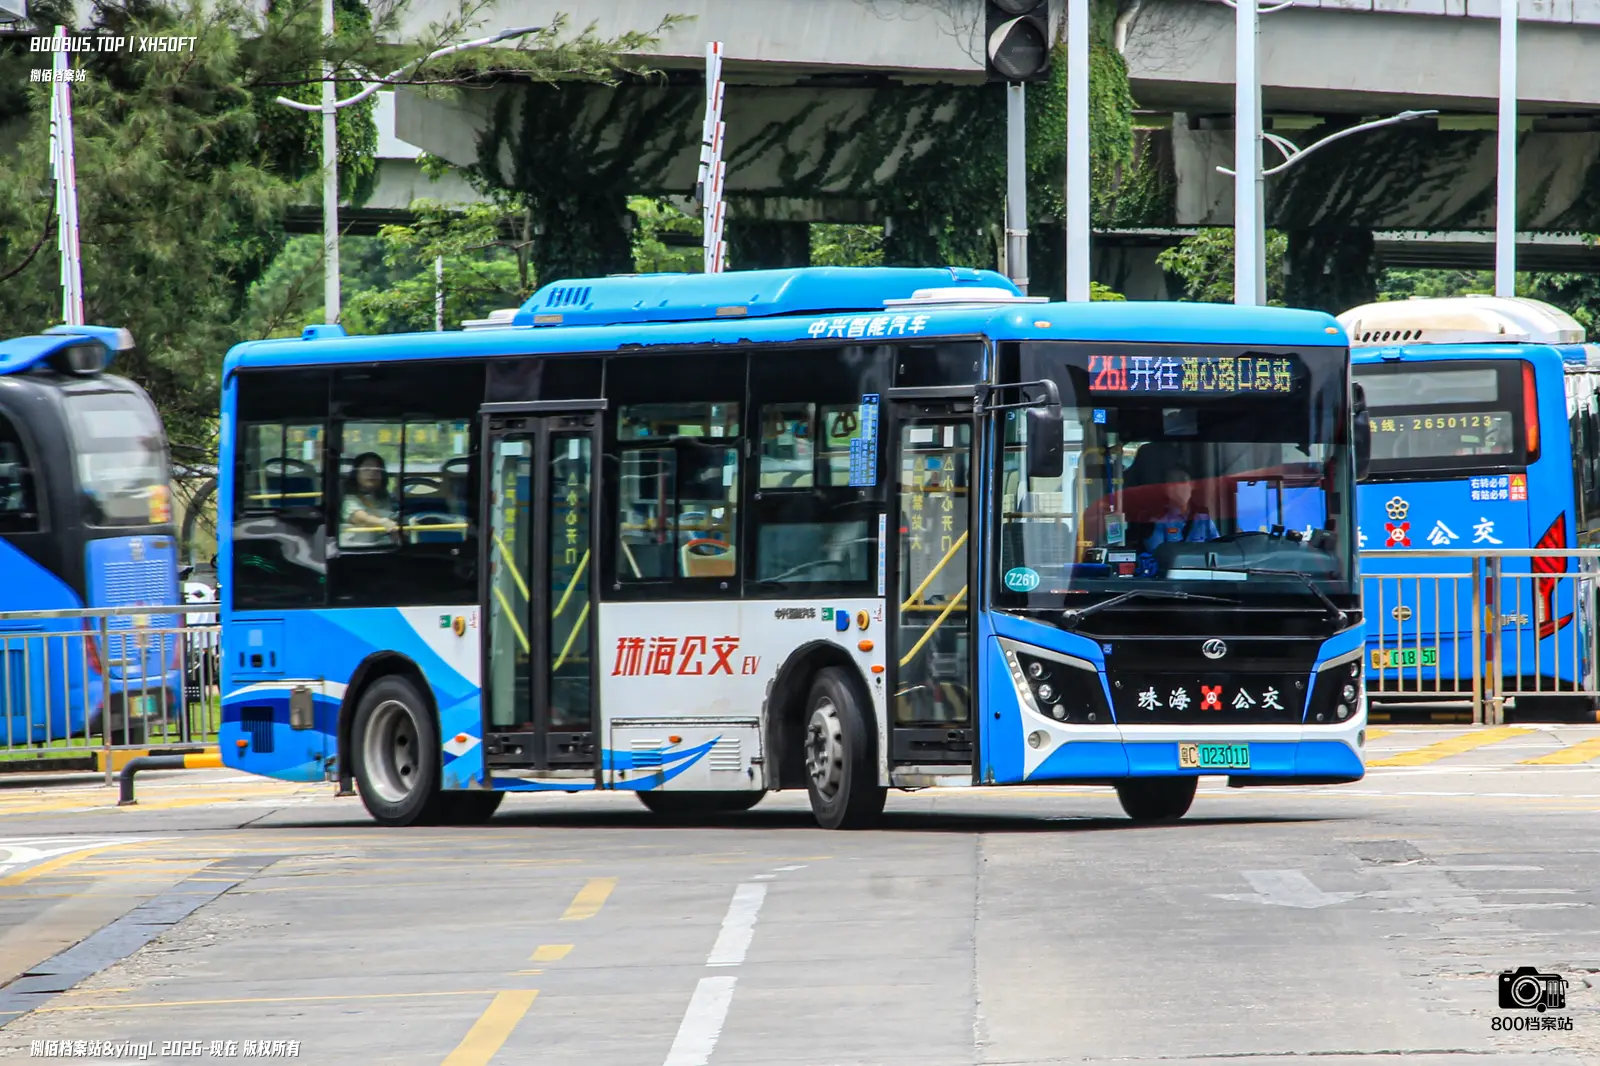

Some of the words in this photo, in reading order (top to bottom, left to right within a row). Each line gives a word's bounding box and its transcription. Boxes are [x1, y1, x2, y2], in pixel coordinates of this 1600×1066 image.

[808, 315, 931, 338] 中兴智能汽车
[1088, 355, 1127, 390] 261
[1427, 517, 1503, 545] 公交
[1009, 572, 1034, 586] Z261
[611, 636, 740, 676] 珠海公交
[741, 656, 761, 675] EV
[1138, 687, 1191, 711] 珠海
[1231, 686, 1284, 711] 公交
